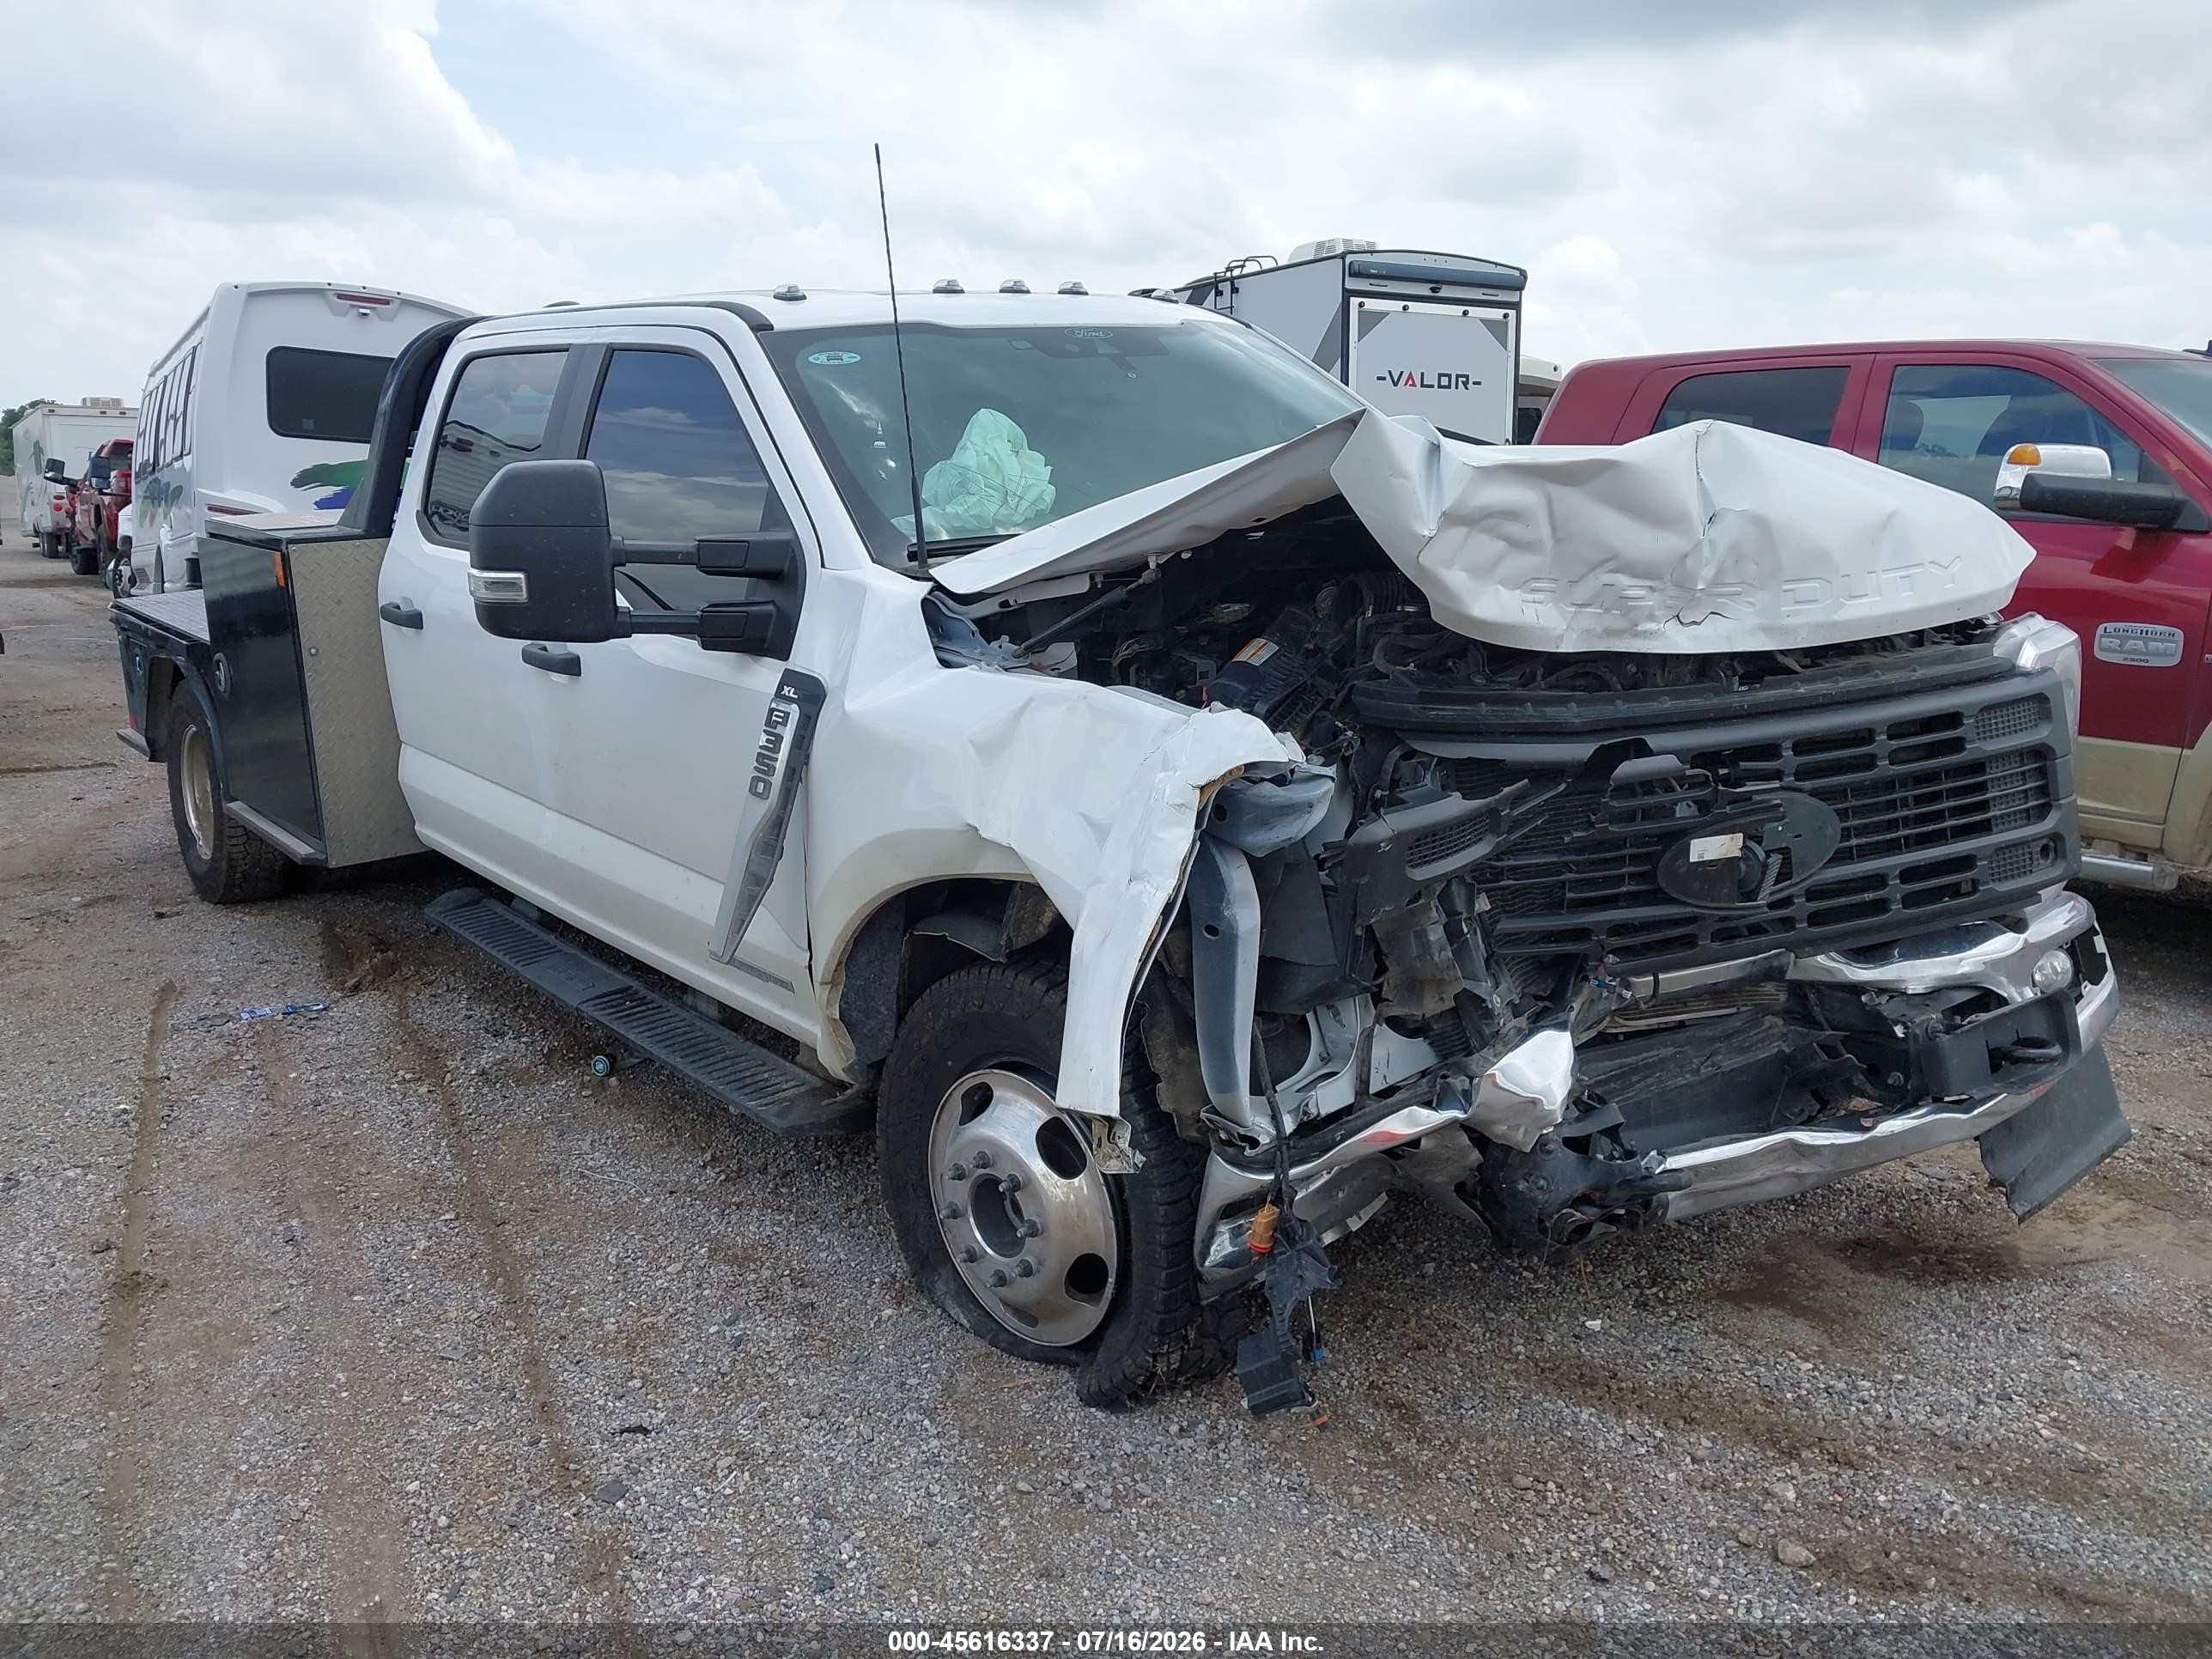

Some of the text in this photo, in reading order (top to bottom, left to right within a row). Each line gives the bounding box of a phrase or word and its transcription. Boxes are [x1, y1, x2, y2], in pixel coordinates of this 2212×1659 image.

[1781, 556, 1965, 611] DUTY
[2100, 637, 2177, 653] RAM
[781, 685, 799, 699] XL
[748, 707, 791, 800] F350
